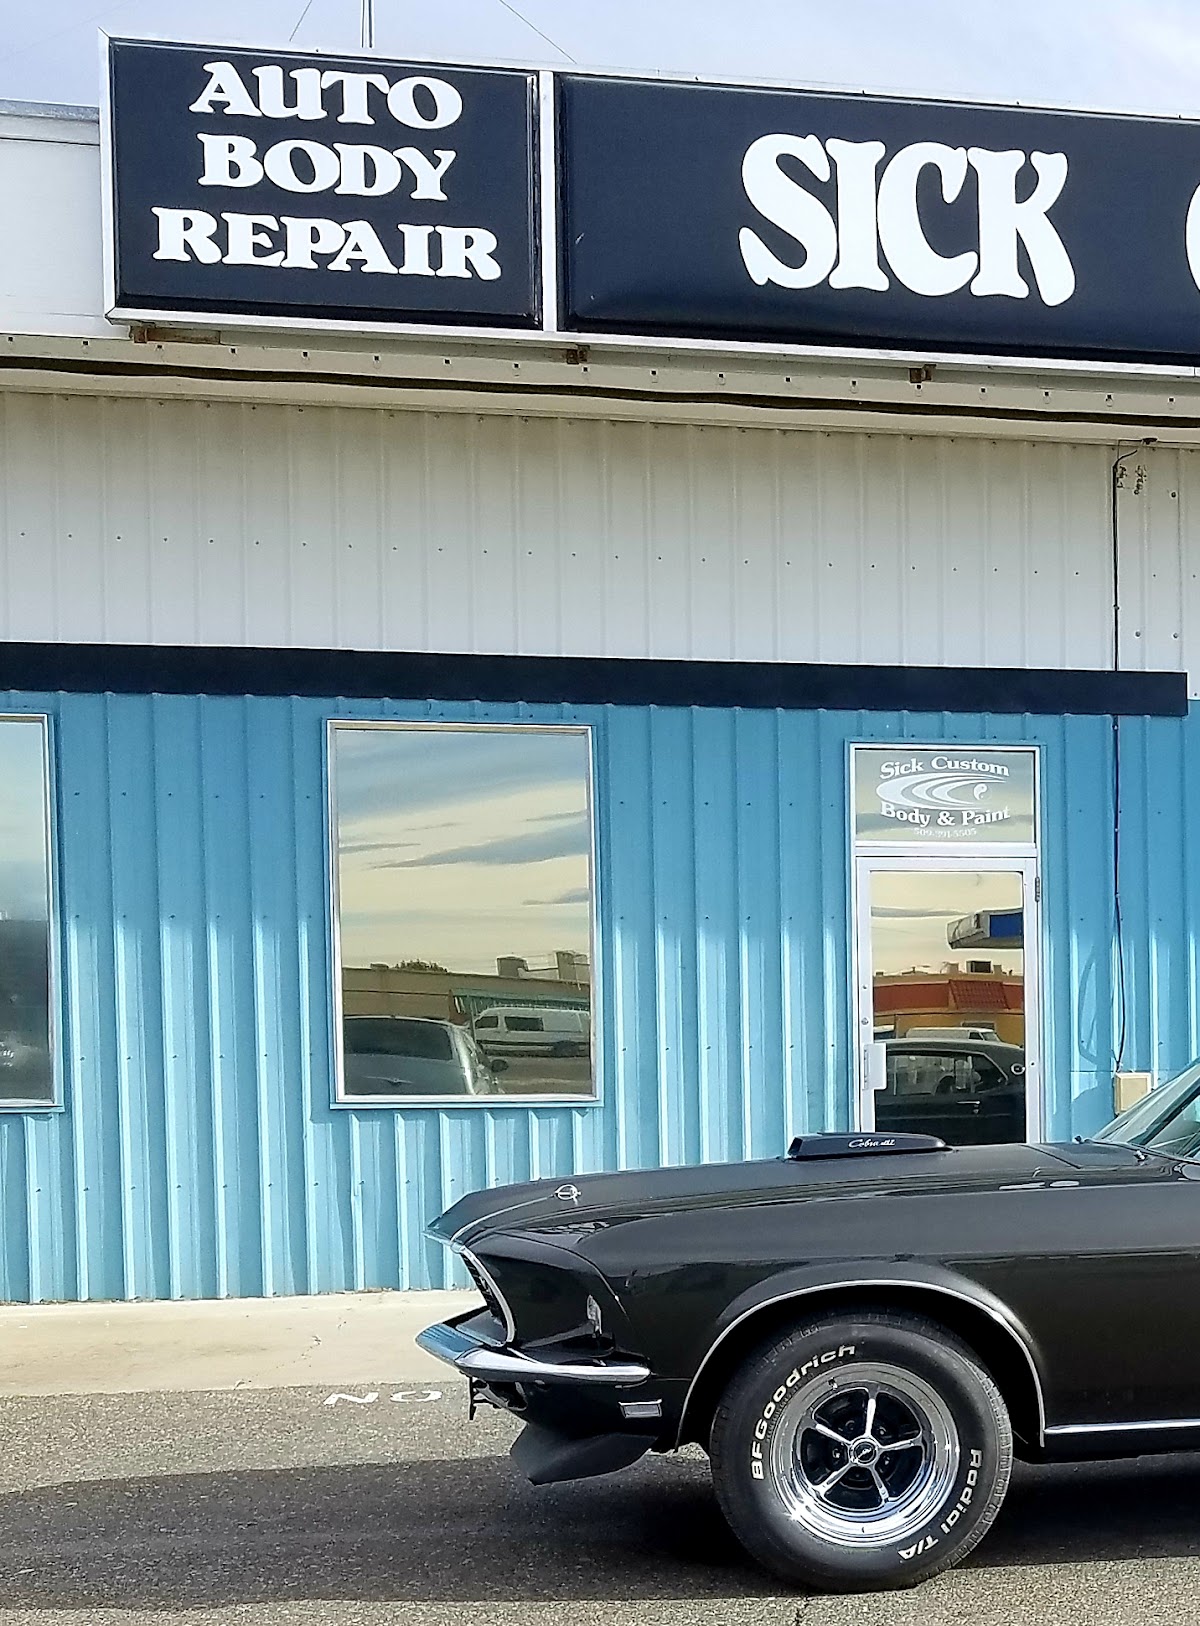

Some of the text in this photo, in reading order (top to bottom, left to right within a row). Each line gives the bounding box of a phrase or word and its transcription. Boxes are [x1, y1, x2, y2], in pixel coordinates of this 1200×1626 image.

[188, 61, 463, 130] AUTO
[195, 132, 457, 201] BODY
[151, 205, 502, 281] REPAIR
[738, 133, 1076, 307] SICK
[879, 755, 1010, 780] Sick Custom
[880, 800, 1011, 828] Body & Paint
[323, 1390, 443, 1406] NO
[751, 1344, 857, 1480] BFGoodrich
[898, 1448, 984, 1560] Radial T/A
